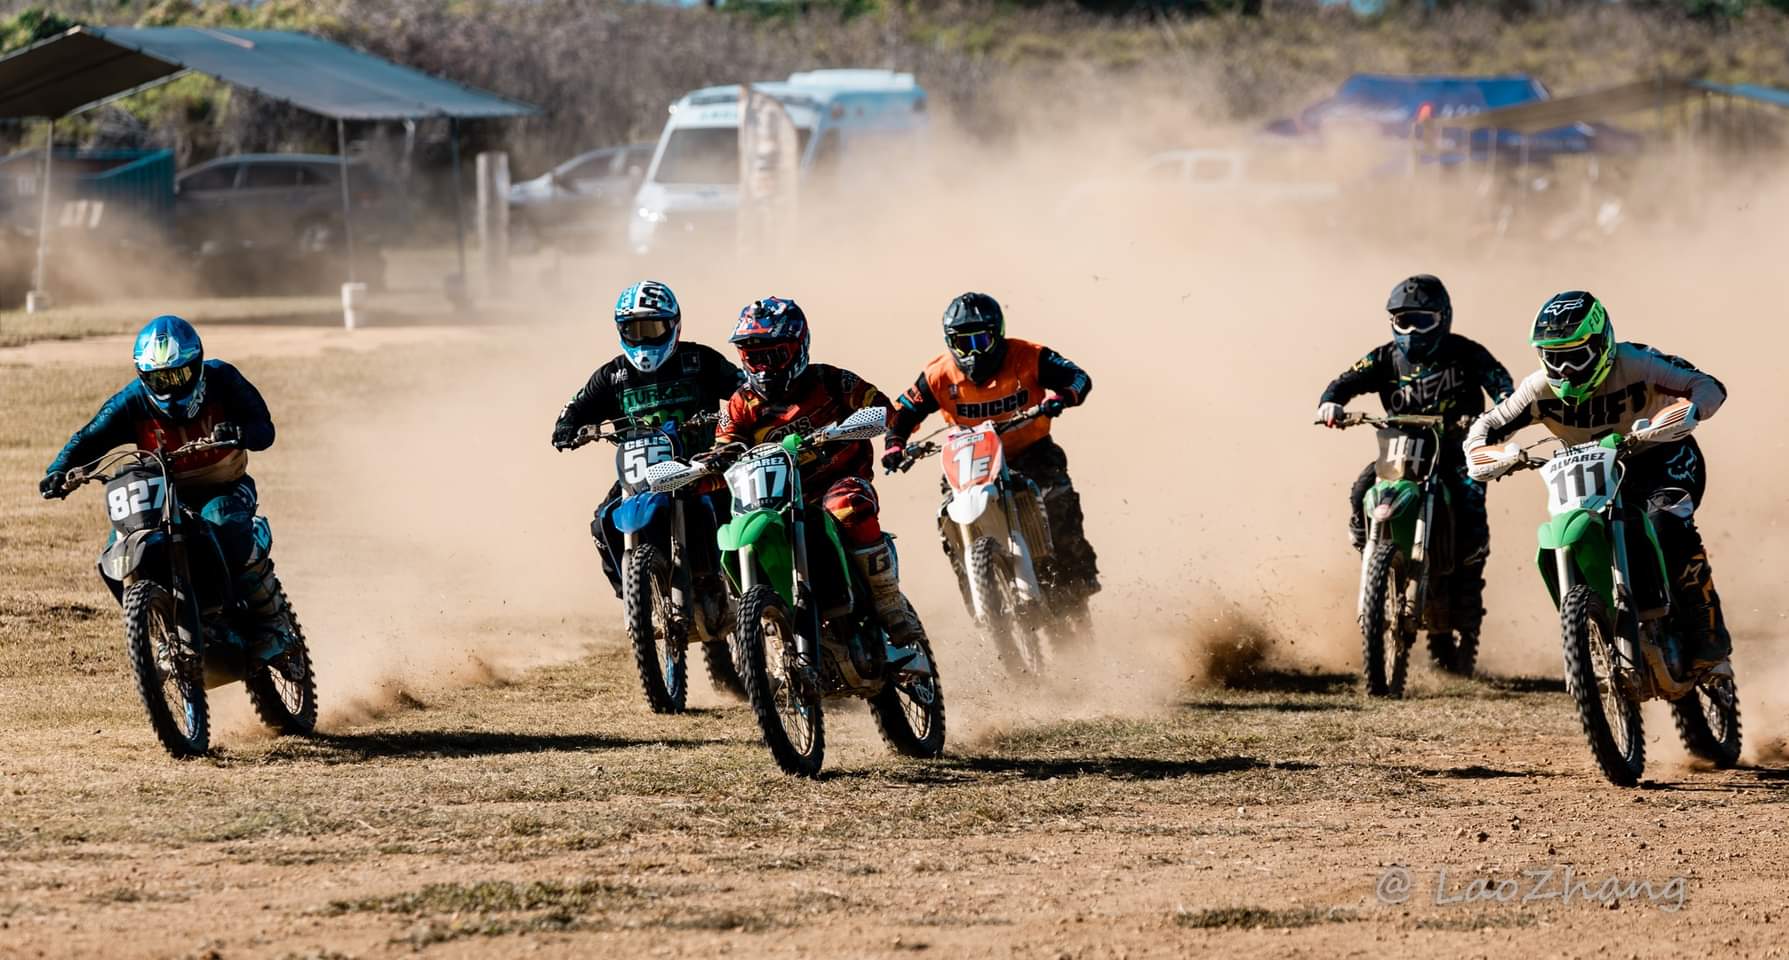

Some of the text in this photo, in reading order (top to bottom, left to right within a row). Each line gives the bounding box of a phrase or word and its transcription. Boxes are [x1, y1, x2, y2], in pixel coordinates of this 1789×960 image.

[956, 389, 1030, 420] ERICCO
[1537, 381, 1648, 429] SHIFT
[624, 435, 671, 451] CELIS
[1386, 435, 1424, 470] 44
[1550, 451, 1606, 473] ALVAREZ
[108, 476, 165, 522] 827
[731, 464, 787, 508] 117
[1551, 462, 1607, 506] 111
